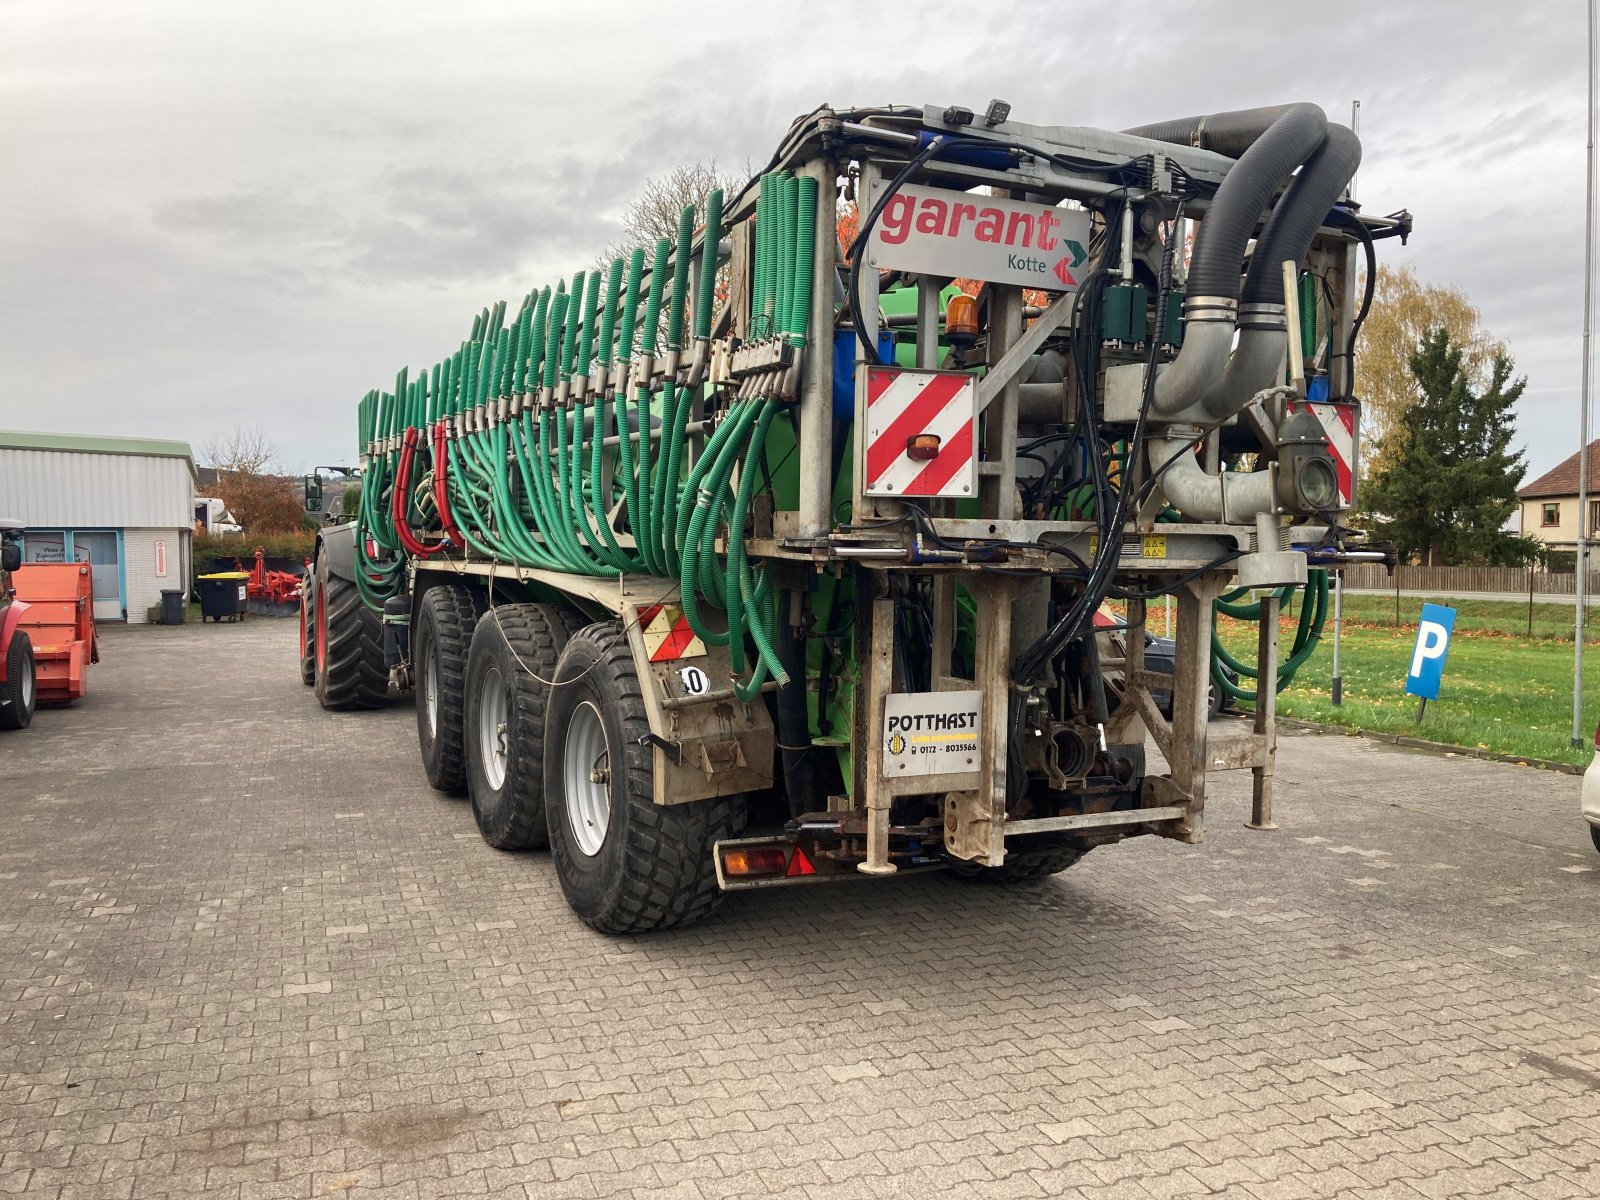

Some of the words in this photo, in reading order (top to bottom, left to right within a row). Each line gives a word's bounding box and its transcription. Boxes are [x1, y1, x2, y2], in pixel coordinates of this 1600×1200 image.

[879, 193, 1061, 251] garant
[1008, 254, 1046, 273] Kotte
[1410, 620, 1448, 678] P
[888, 712, 978, 732] POTTHAST
[920, 746, 937, 754] 0172
[945, 743, 977, 753] 8035566
